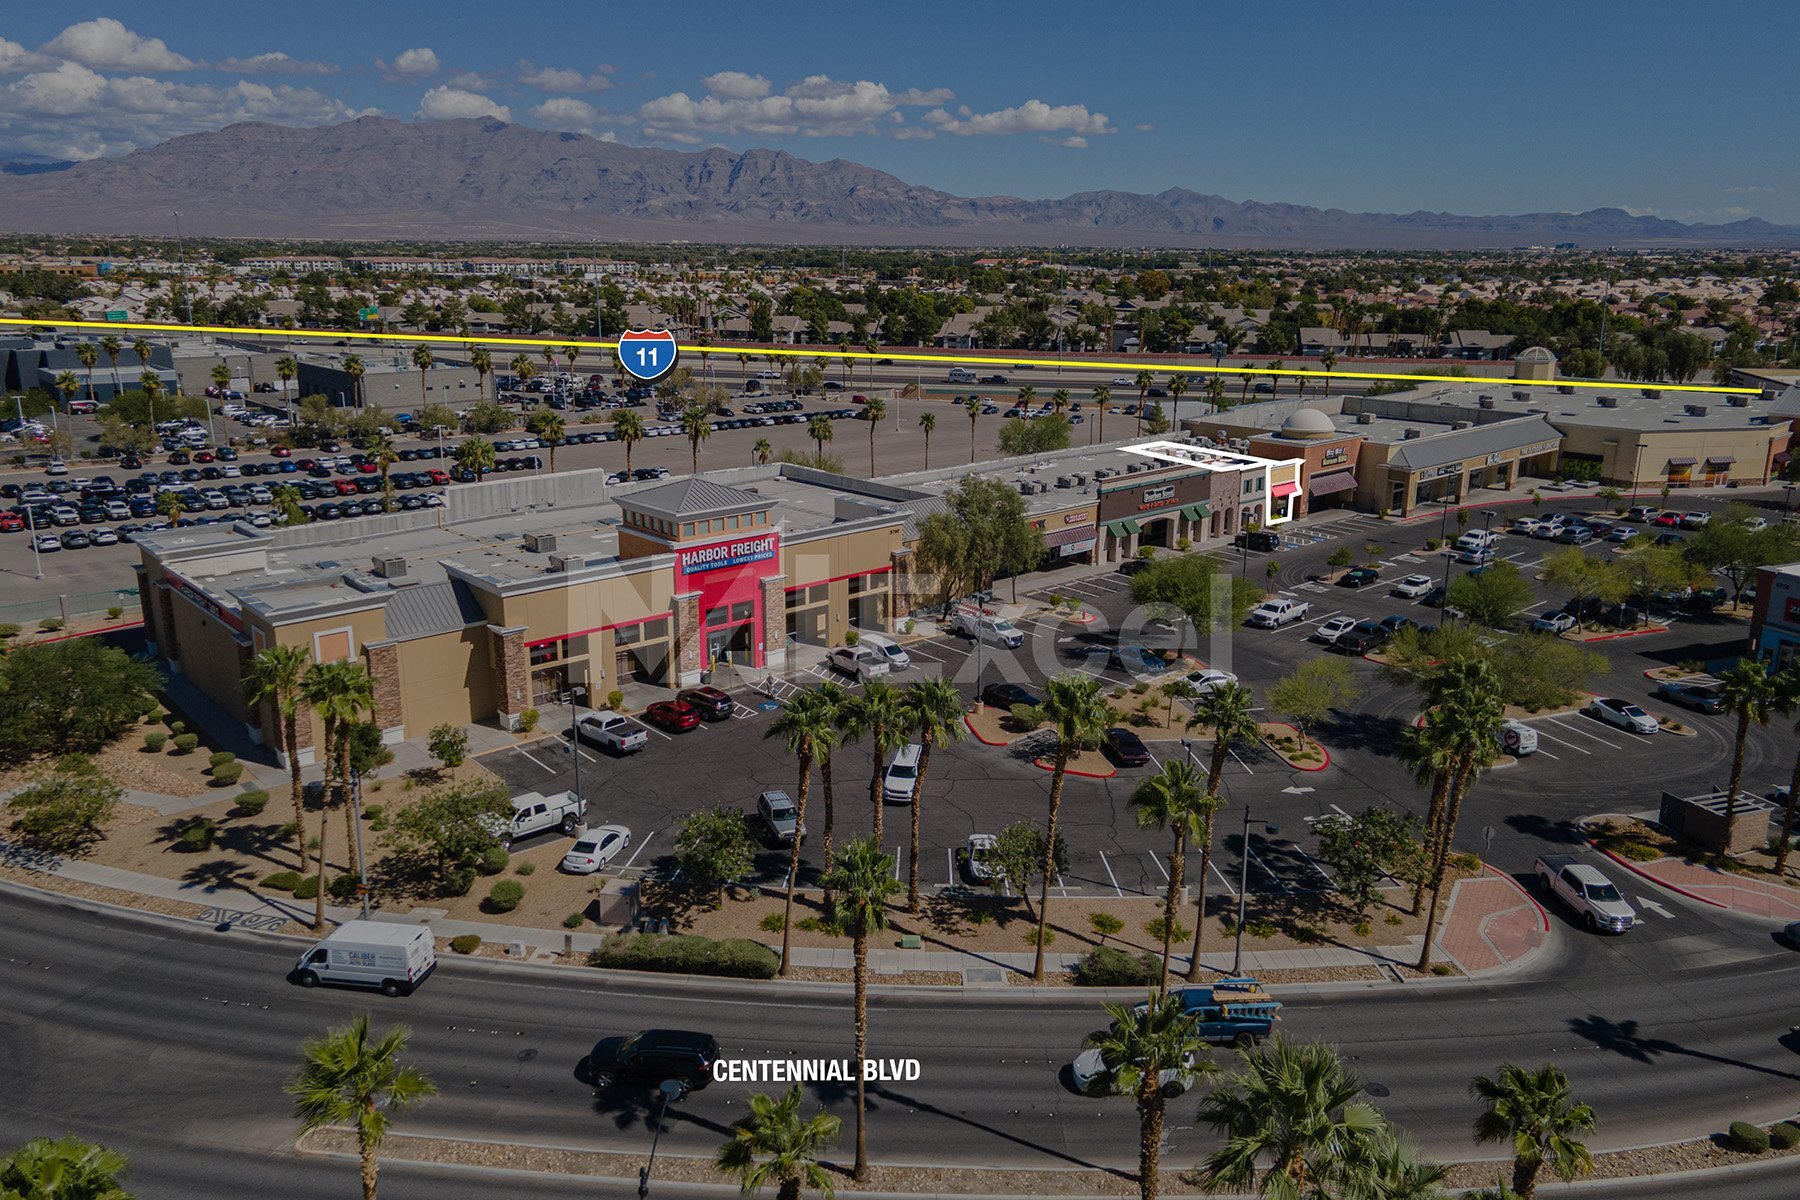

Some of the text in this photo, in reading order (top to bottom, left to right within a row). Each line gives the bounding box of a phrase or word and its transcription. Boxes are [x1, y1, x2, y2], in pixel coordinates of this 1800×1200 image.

[682, 537, 775, 566] HARBOR FREIGHT
[686, 551, 773, 573] QUALITY TOOLS LOWEST PRICES
[348, 951, 376, 960] CALIBER
